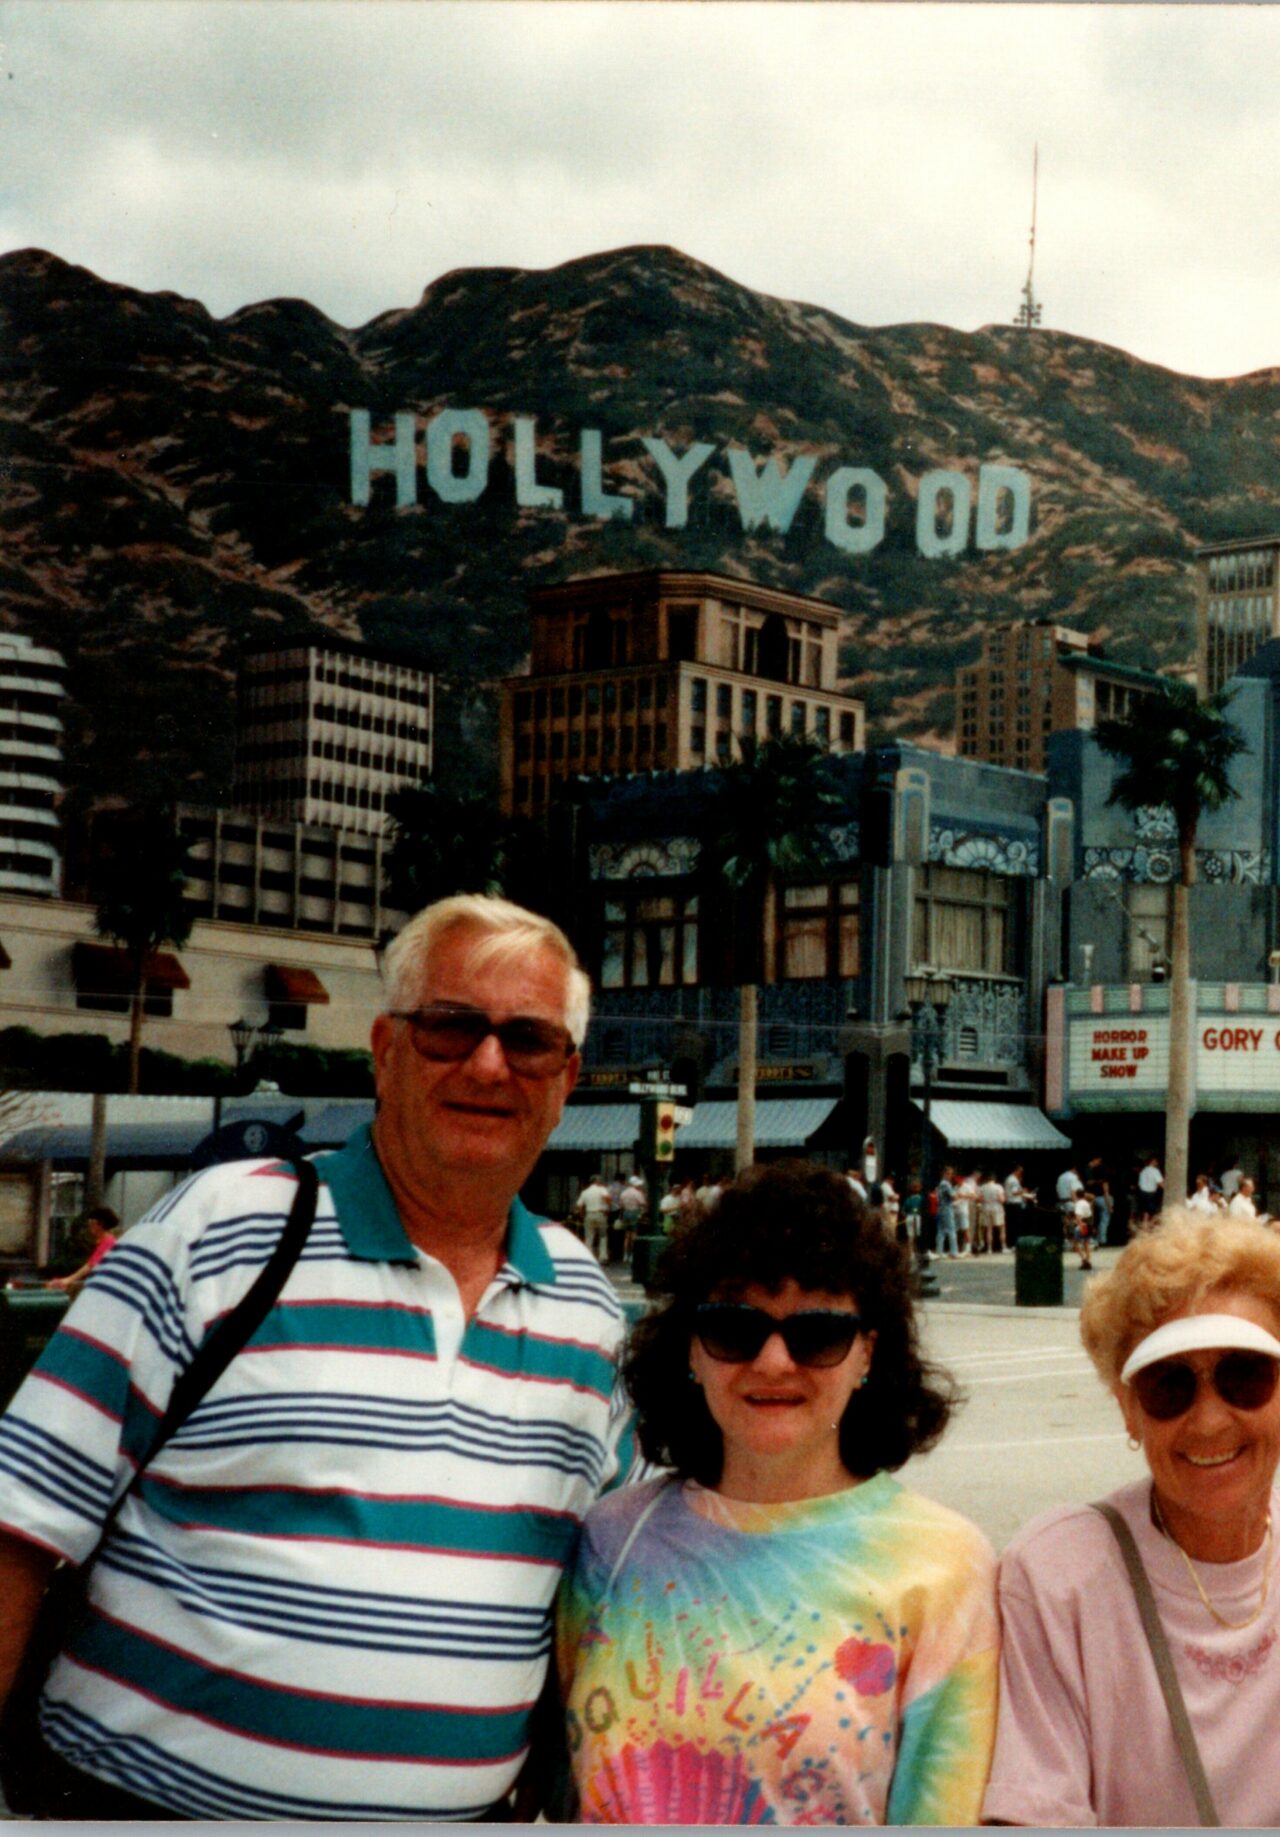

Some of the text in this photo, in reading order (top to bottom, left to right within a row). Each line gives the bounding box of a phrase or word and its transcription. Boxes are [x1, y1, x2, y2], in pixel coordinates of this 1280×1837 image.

[350, 409, 1031, 558] HOLLYWOOD
[1092, 1030, 1147, 1043] HORROR
[1202, 1028, 1263, 1051] GORY
[1091, 1047, 1150, 1061] MAKE UP
[1100, 1064, 1138, 1078] SHOW
